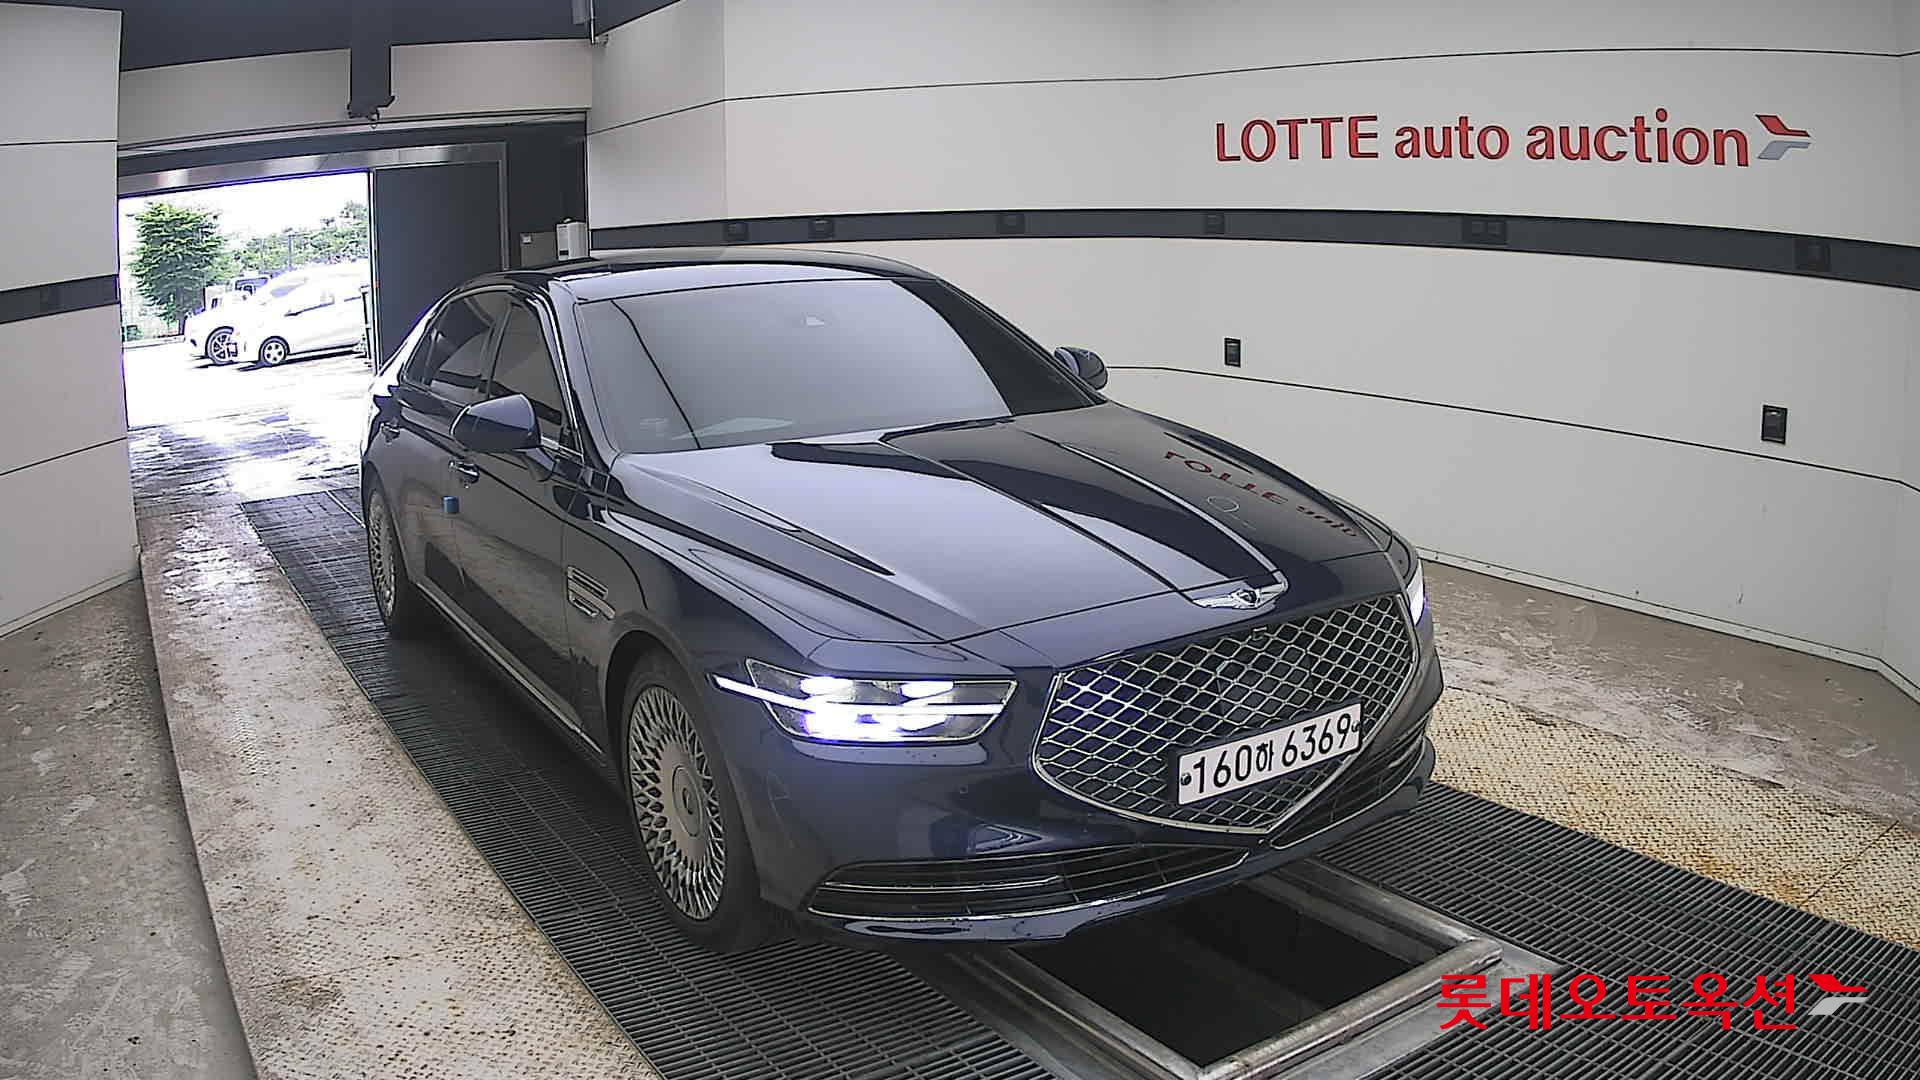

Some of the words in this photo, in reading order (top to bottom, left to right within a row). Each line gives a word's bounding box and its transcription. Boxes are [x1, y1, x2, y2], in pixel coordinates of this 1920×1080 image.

[1215, 115, 1379, 162] LOTTE
[1395, 116, 1510, 161] auto
[1525, 108, 1750, 166] auction
[1281, 713, 1351, 768] 6369
